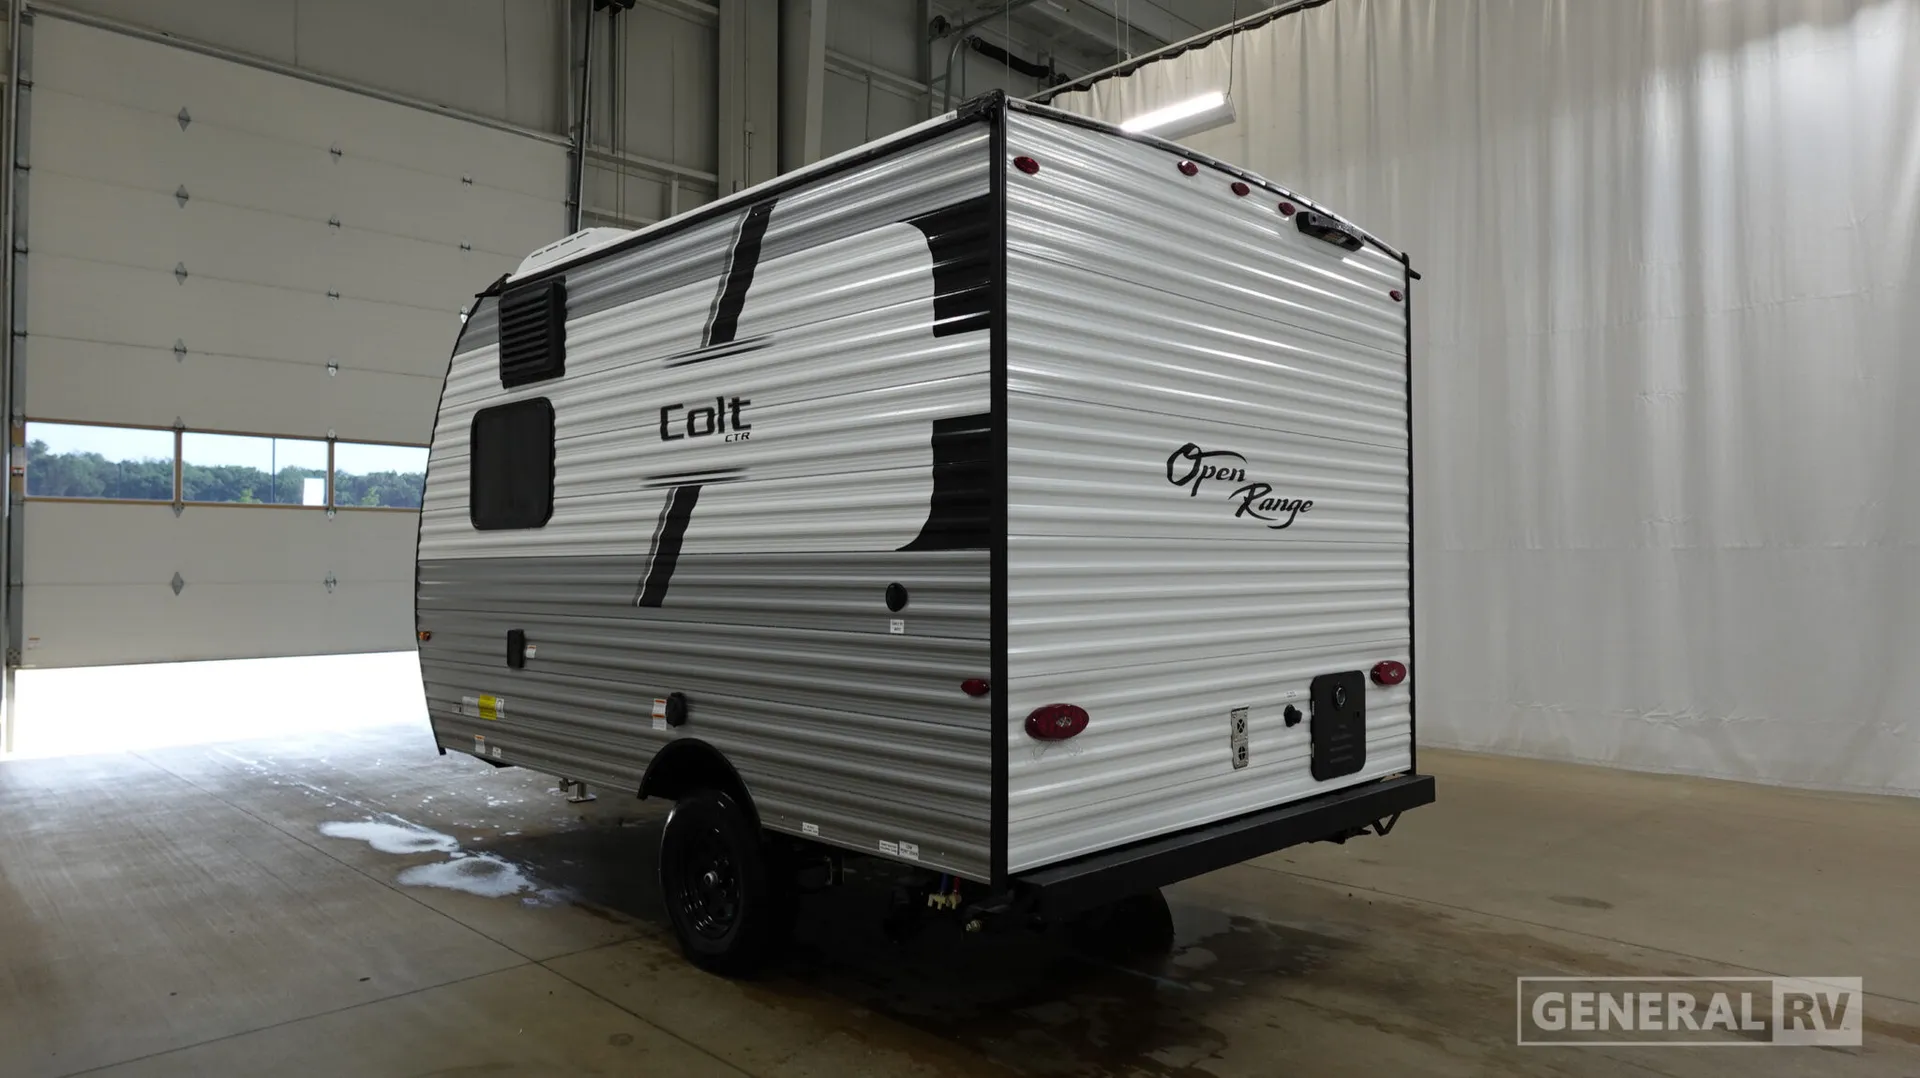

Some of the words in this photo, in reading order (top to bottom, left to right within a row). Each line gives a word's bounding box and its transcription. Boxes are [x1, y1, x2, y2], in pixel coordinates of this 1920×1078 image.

[660, 396, 751, 442] Colt
[725, 432, 750, 443] CTR
[1167, 442, 1248, 497] Open
[1228, 482, 1314, 530] Range
